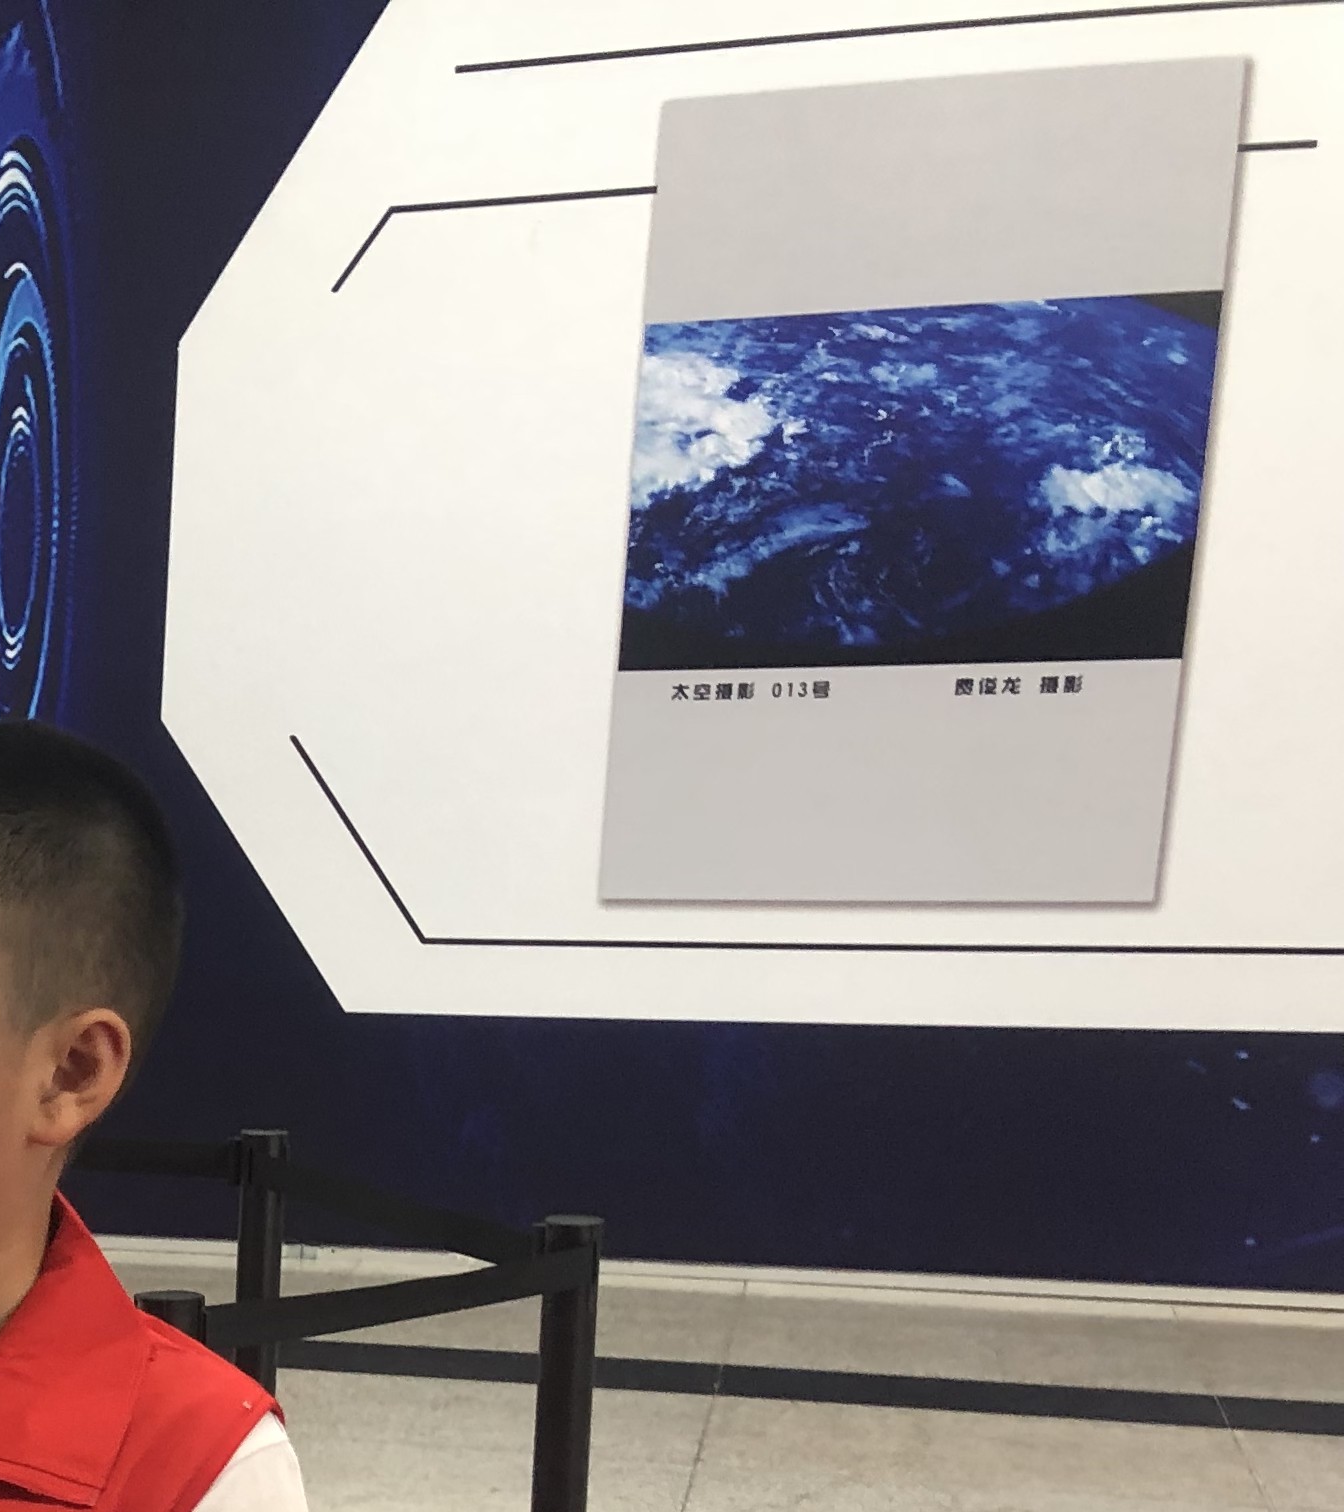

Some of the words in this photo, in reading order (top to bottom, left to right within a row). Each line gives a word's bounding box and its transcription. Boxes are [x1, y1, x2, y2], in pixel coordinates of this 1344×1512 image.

[671, 682, 756, 701] 太空摄影
[771, 680, 831, 699] 013号
[1040, 675, 1083, 694] 摄影
